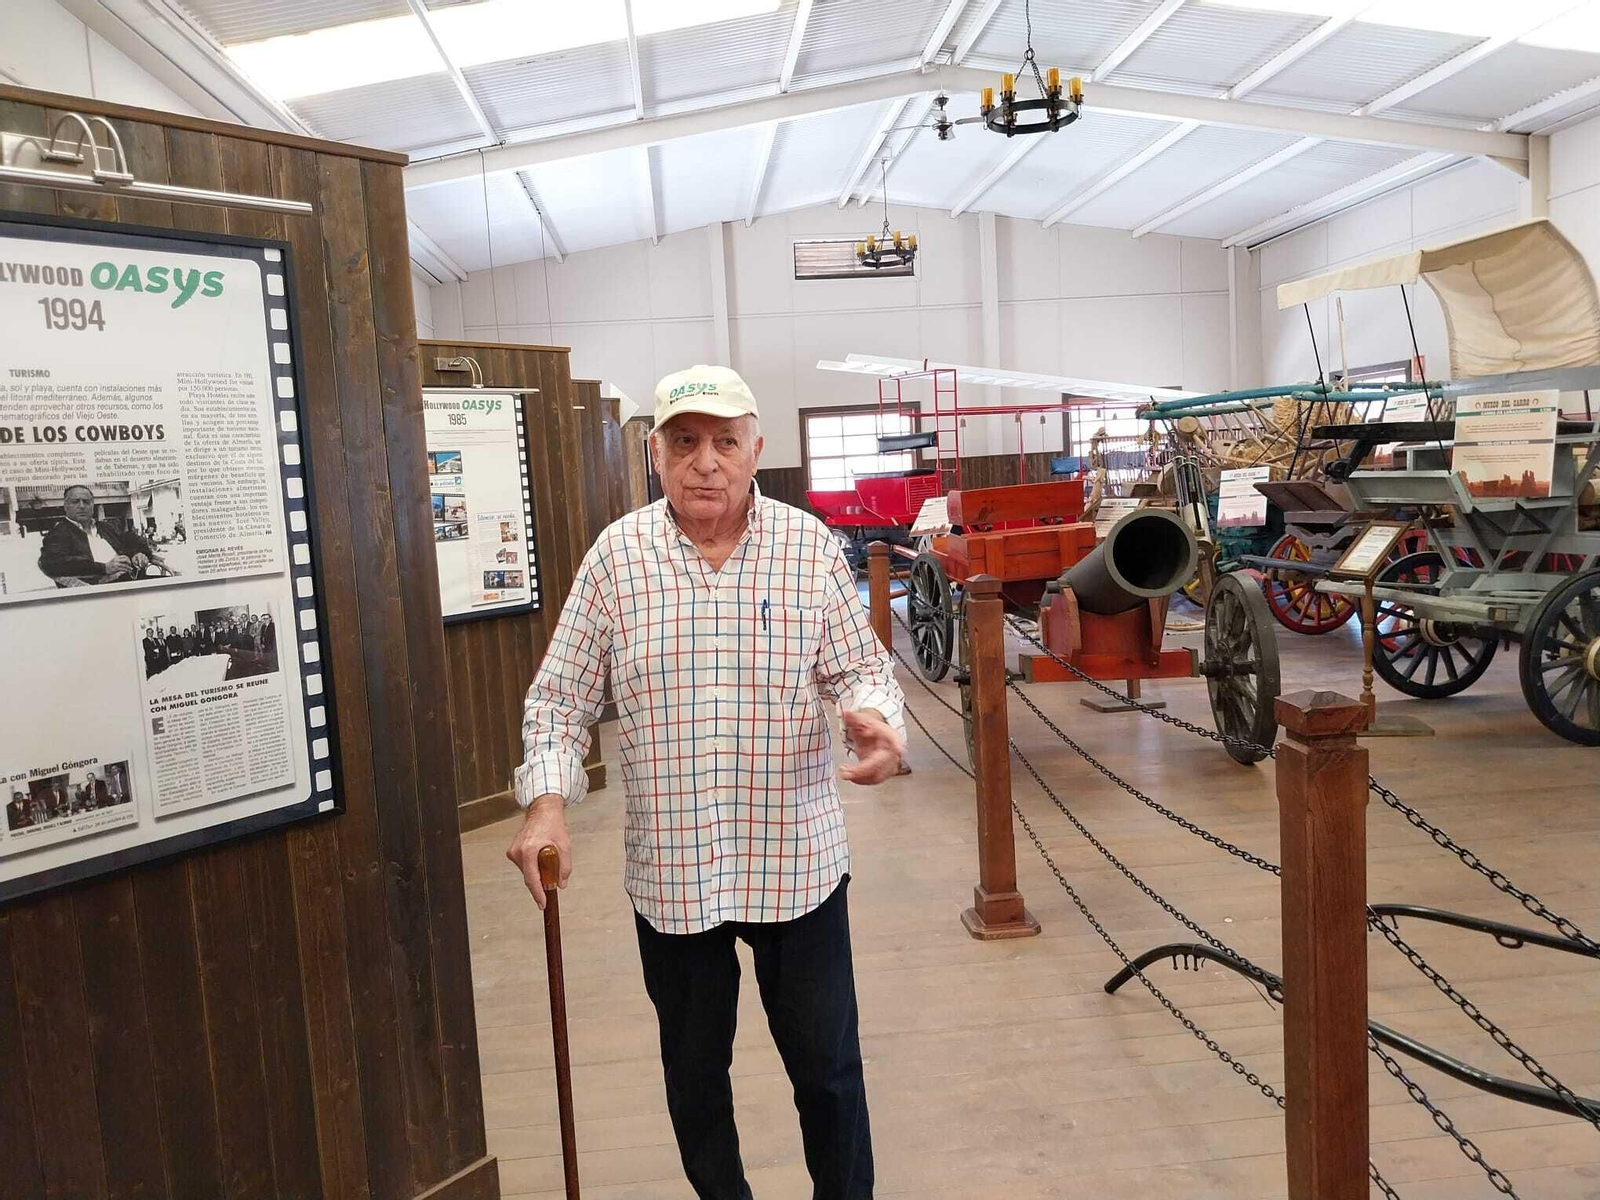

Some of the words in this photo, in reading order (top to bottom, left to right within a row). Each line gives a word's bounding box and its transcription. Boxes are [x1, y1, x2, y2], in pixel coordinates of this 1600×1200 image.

[38, 297, 106, 332] 1994
[9, 369, 51, 378] TURISMO
[10, 384, 22, 393] sol
[57, 385, 83, 393] cuenta
[100, 384, 146, 393] instalaciones
[147, 385, 163, 393] más
[10, 393, 33, 401] litoral
[124, 394, 153, 403] algunos
[30, 403, 74, 413] aprovechar
[75, 403, 95, 411] otros
[153, 402, 164, 410] los
[62, 412, 74, 420] del
[447, 413, 467, 426] 1985
[0, 426, 25, 443] DE
[32, 425, 68, 443] LOS
[75, 424, 165, 442] COWBOYS
[149, 698, 159, 706] LA
[161, 694, 183, 704] MESA
[184, 690, 199, 699] DEL
[200, 684, 234, 697] TURISMO
[235, 682, 245, 690] SE
[246, 678, 269, 688] REUNE
[150, 705, 167, 714] CON
[169, 700, 198, 711] MIGUEL
[200, 691, 239, 705] GONGORA
[10, 772, 27, 782] con
[29, 763, 60, 777] Miguel
[61, 757, 98, 771] Góngora
